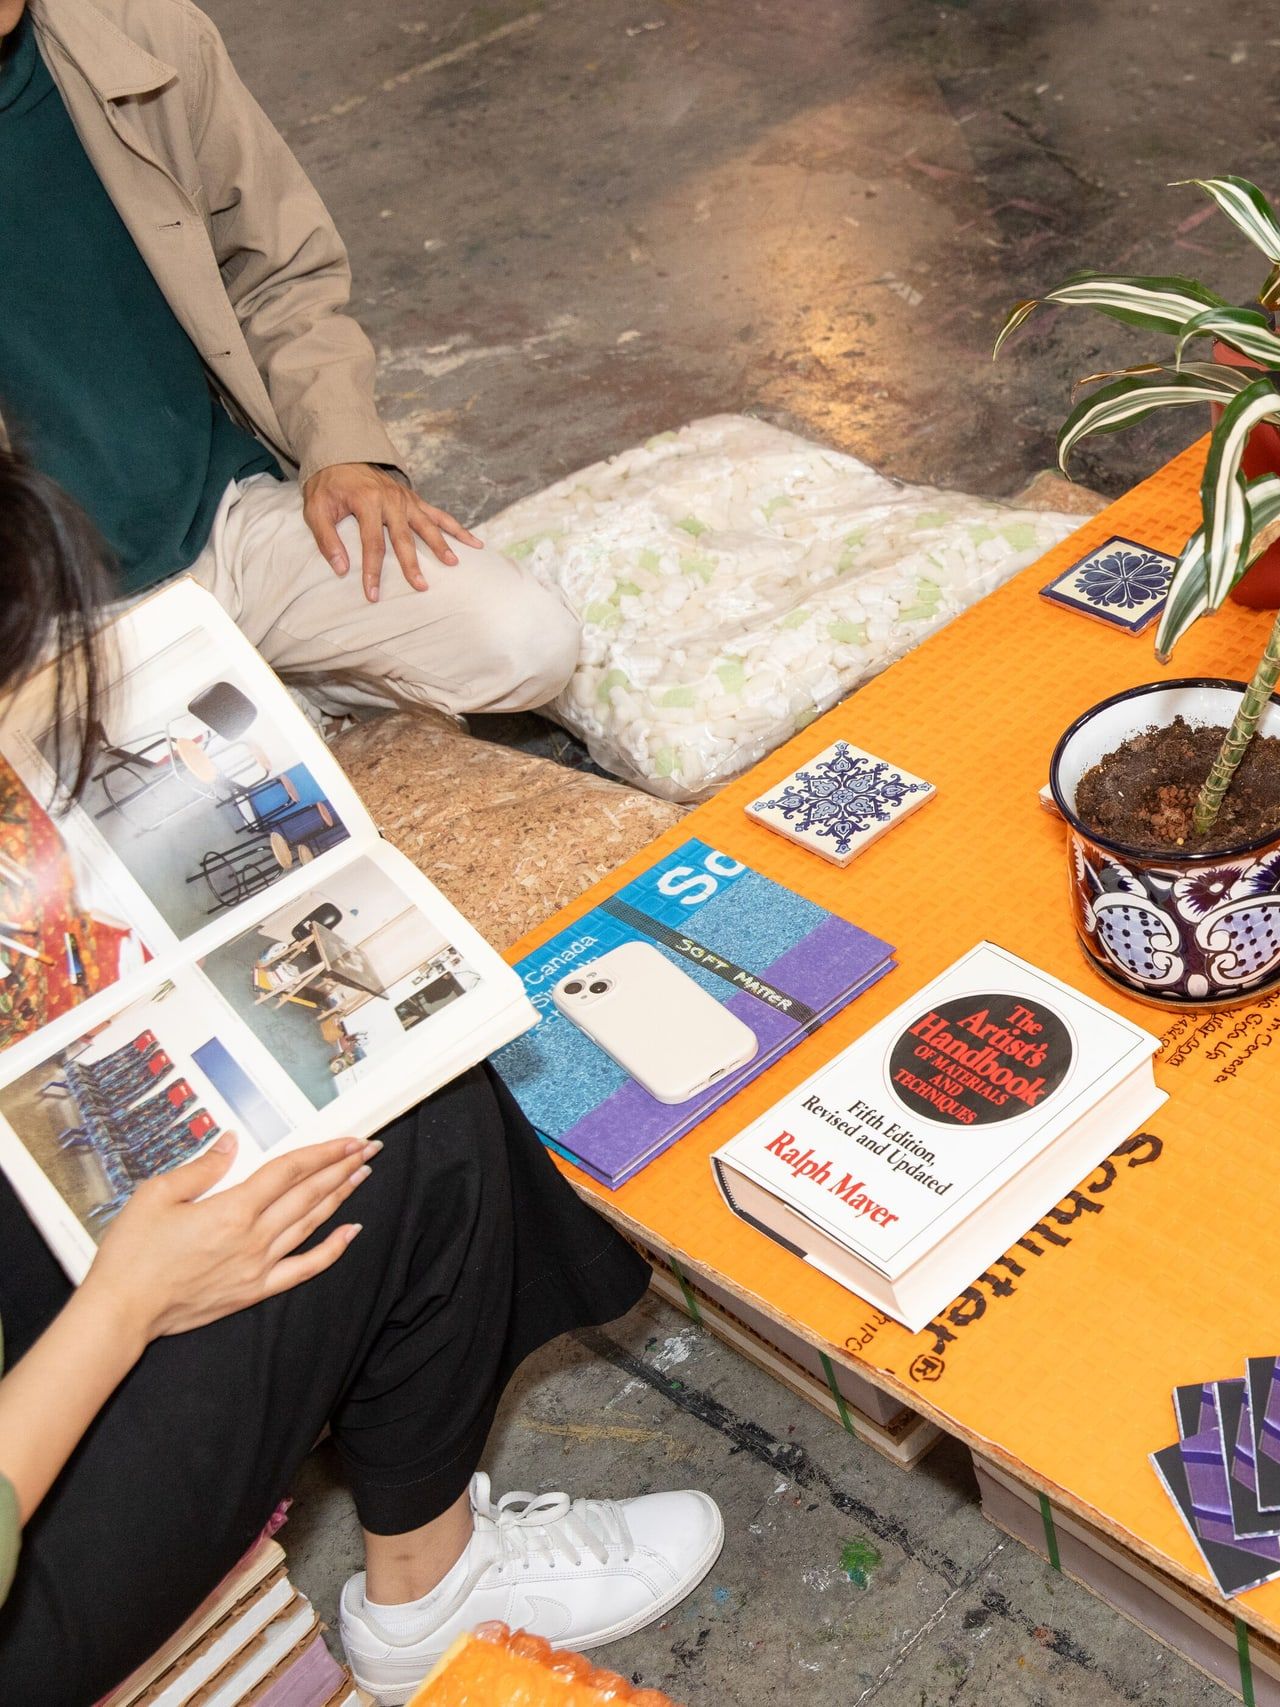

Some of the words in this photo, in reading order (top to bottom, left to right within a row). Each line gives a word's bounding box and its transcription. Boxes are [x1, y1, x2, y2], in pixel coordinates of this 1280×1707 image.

[525, 936, 598, 984] Canada
[676, 938, 729, 970] SOFT
[733, 972, 793, 1010] MATTER
[956, 1008, 1048, 1068] Artist's
[1006, 1004, 1044, 1035] The
[908, 1011, 1046, 1107] Handbook
[914, 1045, 936, 1062] OF
[930, 1055, 1009, 1105] MATERIALS
[928, 1073, 964, 1097] AND
[893, 1068, 977, 1125] TECHNIQUES
[801, 1095, 862, 1137] Revised
[856, 1133, 891, 1156] and
[887, 1149, 954, 1196] Updated
[847, 1100, 884, 1131] Fifth
[883, 1123, 936, 1167] Edition,
[764, 1130, 833, 1186] Ralph
[828, 1173, 899, 1228] Mayer
